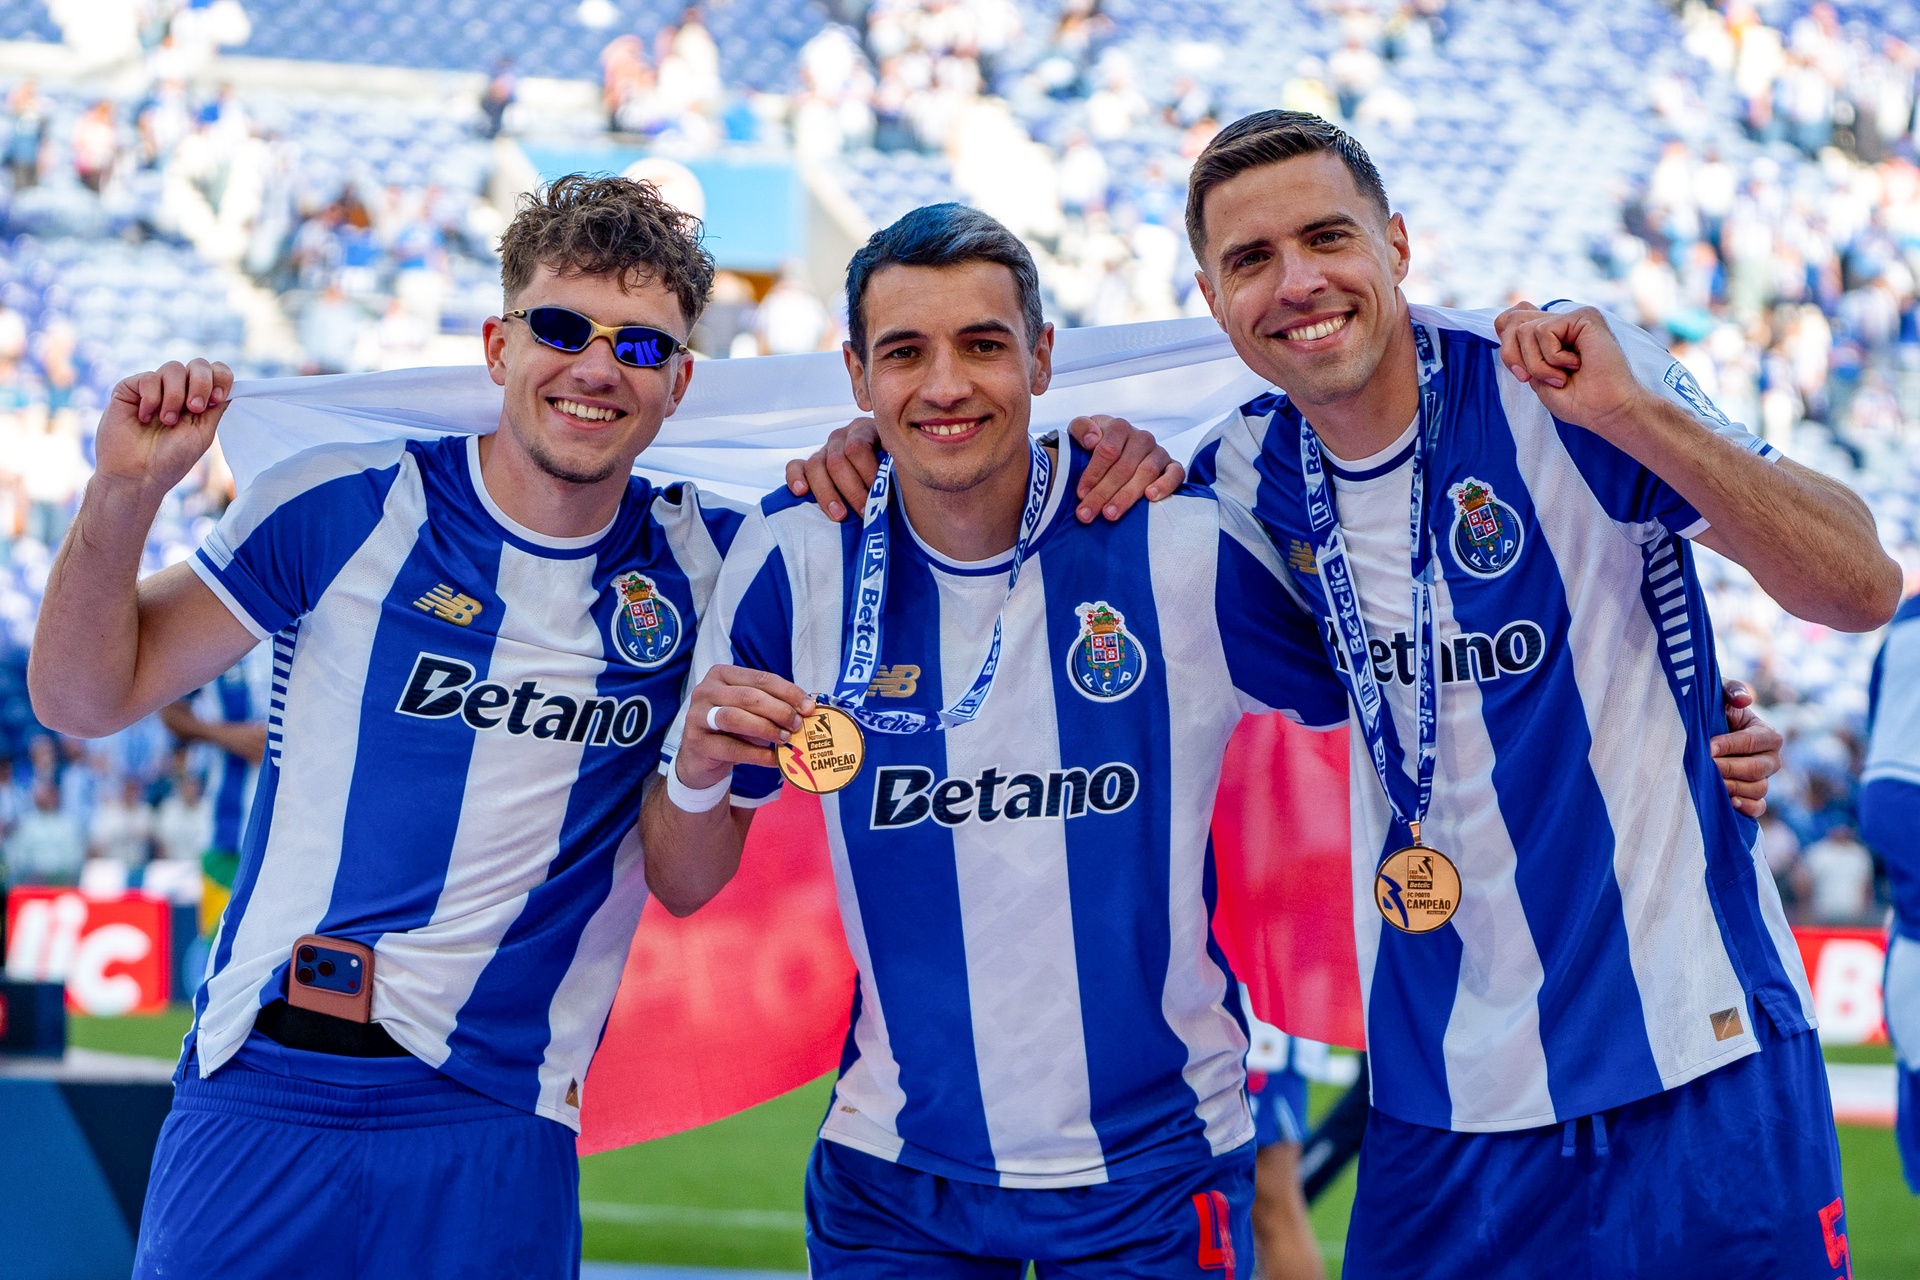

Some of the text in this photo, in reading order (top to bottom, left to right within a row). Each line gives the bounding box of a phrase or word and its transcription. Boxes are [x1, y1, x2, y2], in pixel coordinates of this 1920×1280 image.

[849, 588, 880, 680] Betclic
[1330, 561, 1365, 655] Betclic
[396, 653, 651, 746] Betano
[810, 753, 856, 771] CAMPEÃO
[871, 763, 1138, 829] Betano
[1406, 898, 1451, 910] CAMPEÃO
